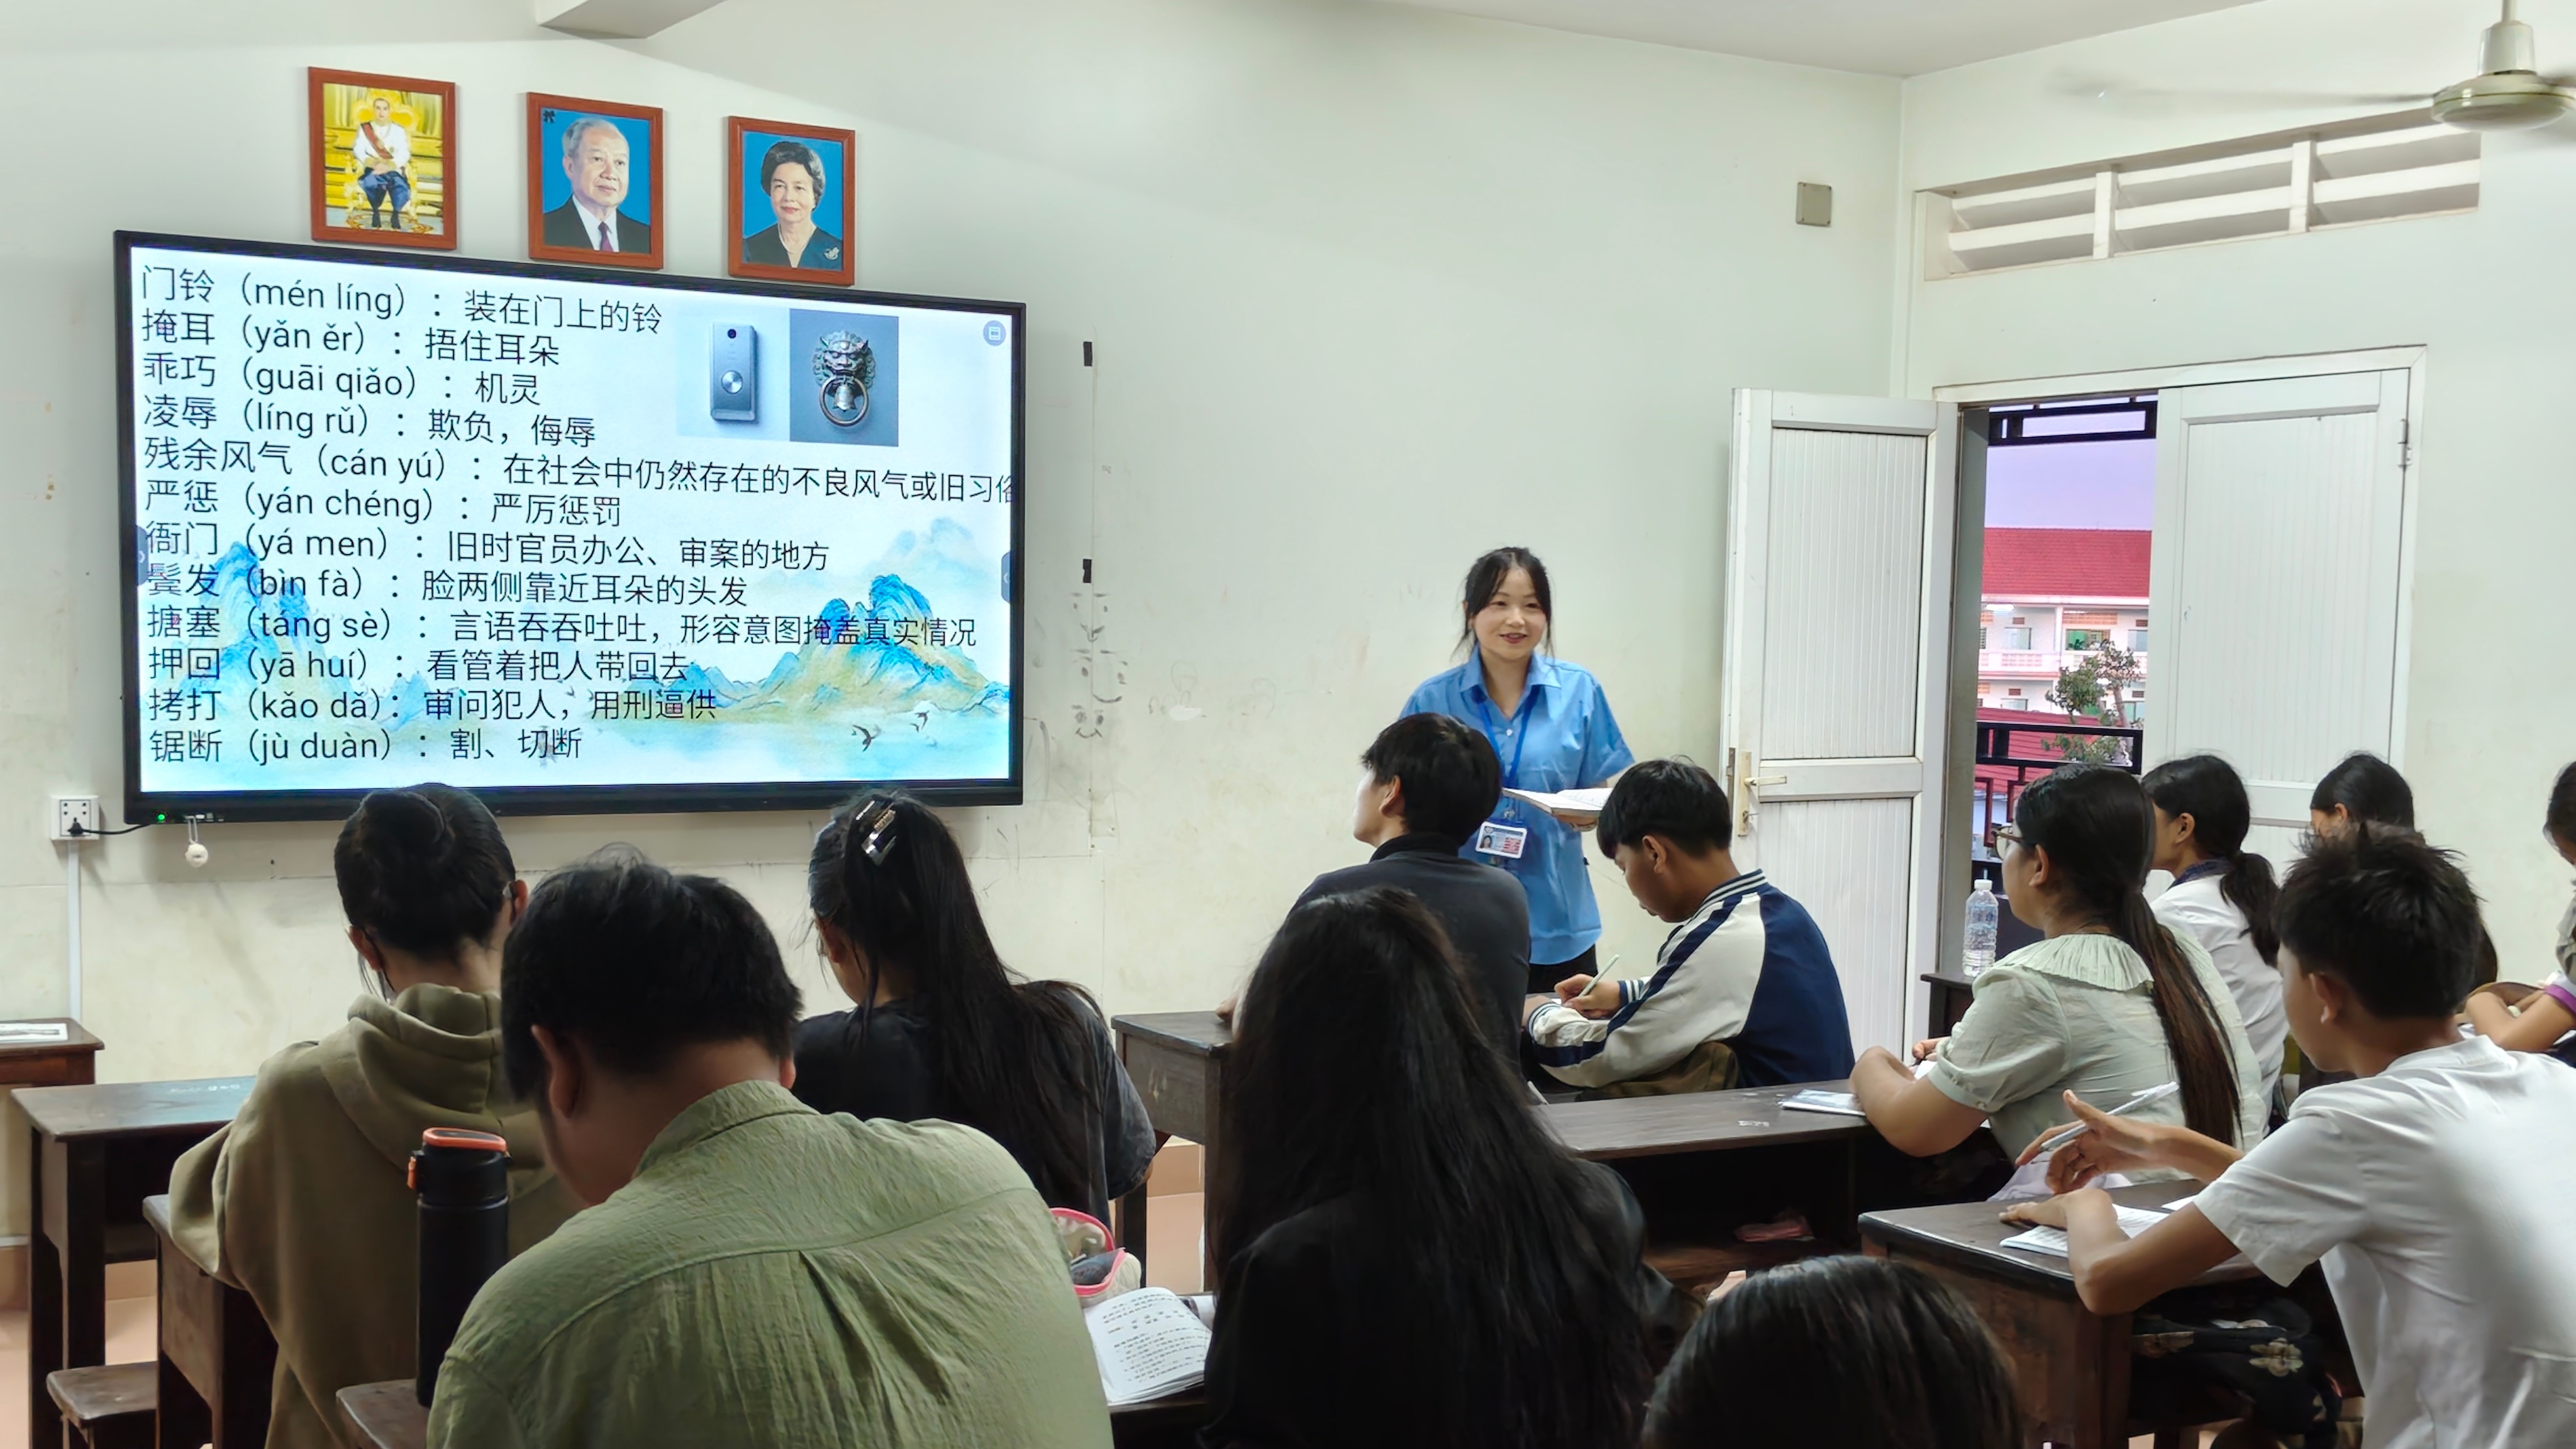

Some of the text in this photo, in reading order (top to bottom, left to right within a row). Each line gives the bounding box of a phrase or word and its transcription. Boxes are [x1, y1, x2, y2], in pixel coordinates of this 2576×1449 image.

[143, 265, 214, 303] 门铃
[142, 308, 215, 345] 掩耳
[143, 352, 216, 387] 乖巧
[144, 394, 217, 430] 凌辱
[145, 436, 292, 475] 残余风气
[146, 480, 218, 513] 严惩
[145, 521, 218, 555] 衙门
[147, 604, 220, 638] 搪塞
[148, 647, 219, 680] 押回
[149, 688, 221, 721] 拷打
[150, 729, 223, 762] 锯断
